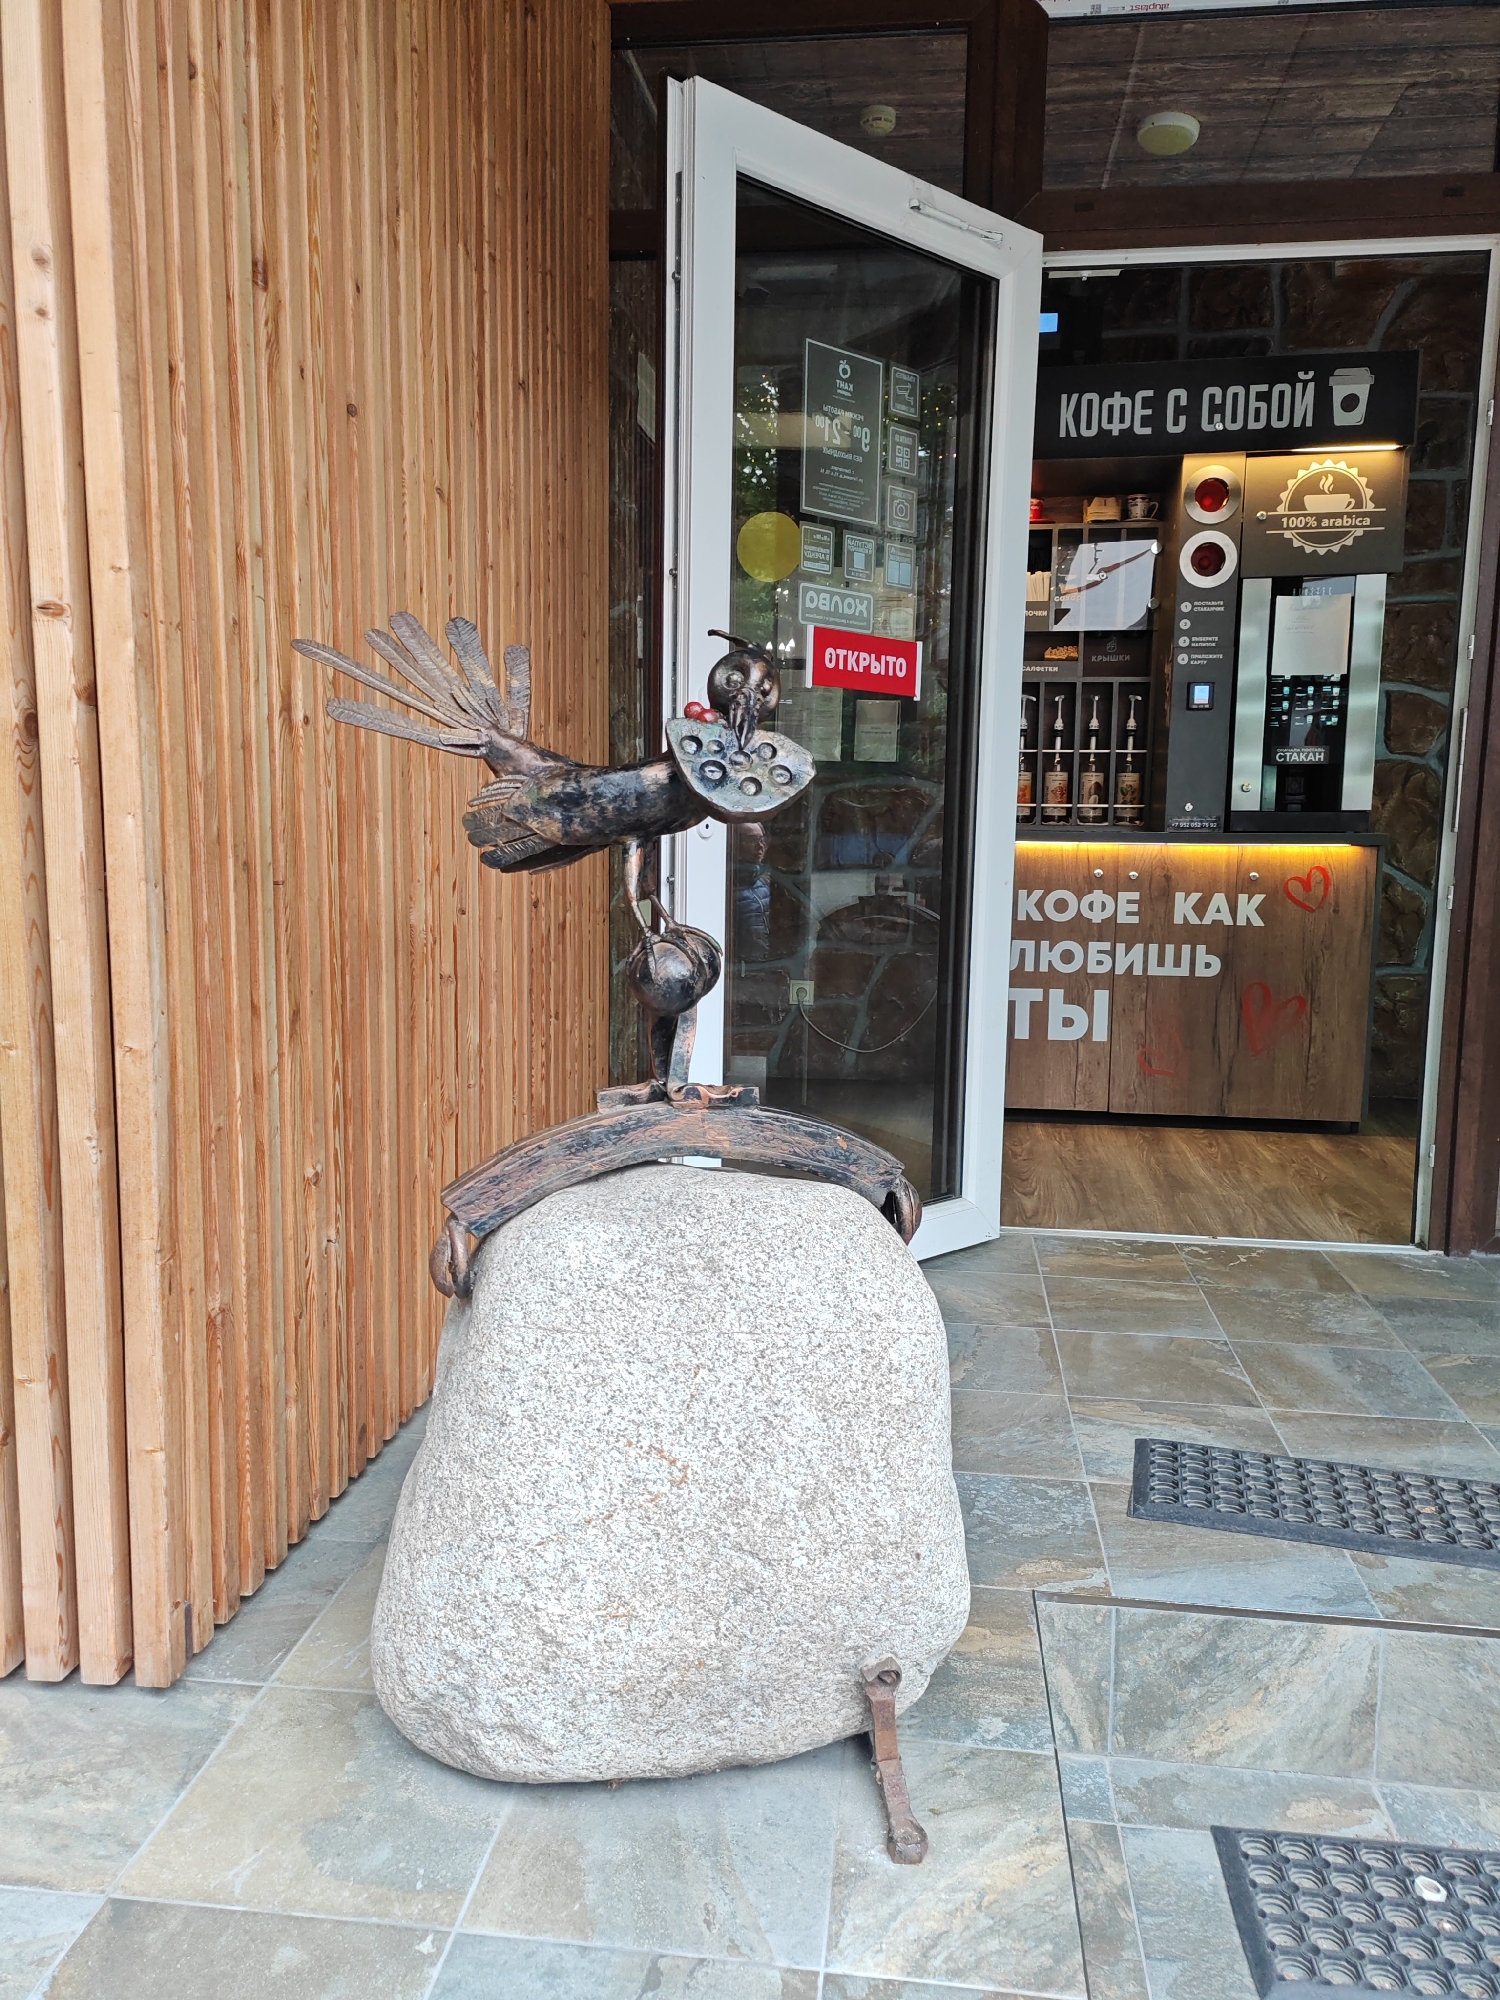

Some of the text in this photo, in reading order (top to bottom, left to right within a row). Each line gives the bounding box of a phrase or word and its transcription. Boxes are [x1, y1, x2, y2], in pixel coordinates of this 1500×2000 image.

[1130, 3, 1169, 11] aluplast
[1060, 371, 1315, 437] КОФЕ С СОБОЙ
[1281, 514, 1371, 528] 100% arabica
[824, 647, 907, 678] ОТКРЫТО
[1091, 654, 1130, 662] КРЫШКИ
[1275, 752, 1324, 762] СТАКАН
[1016, 889, 1267, 926] КОФЕ КАК
[1010, 940, 1221, 978] ЛЮБИШЬ
[1009, 988, 1109, 1041] ТЫ
